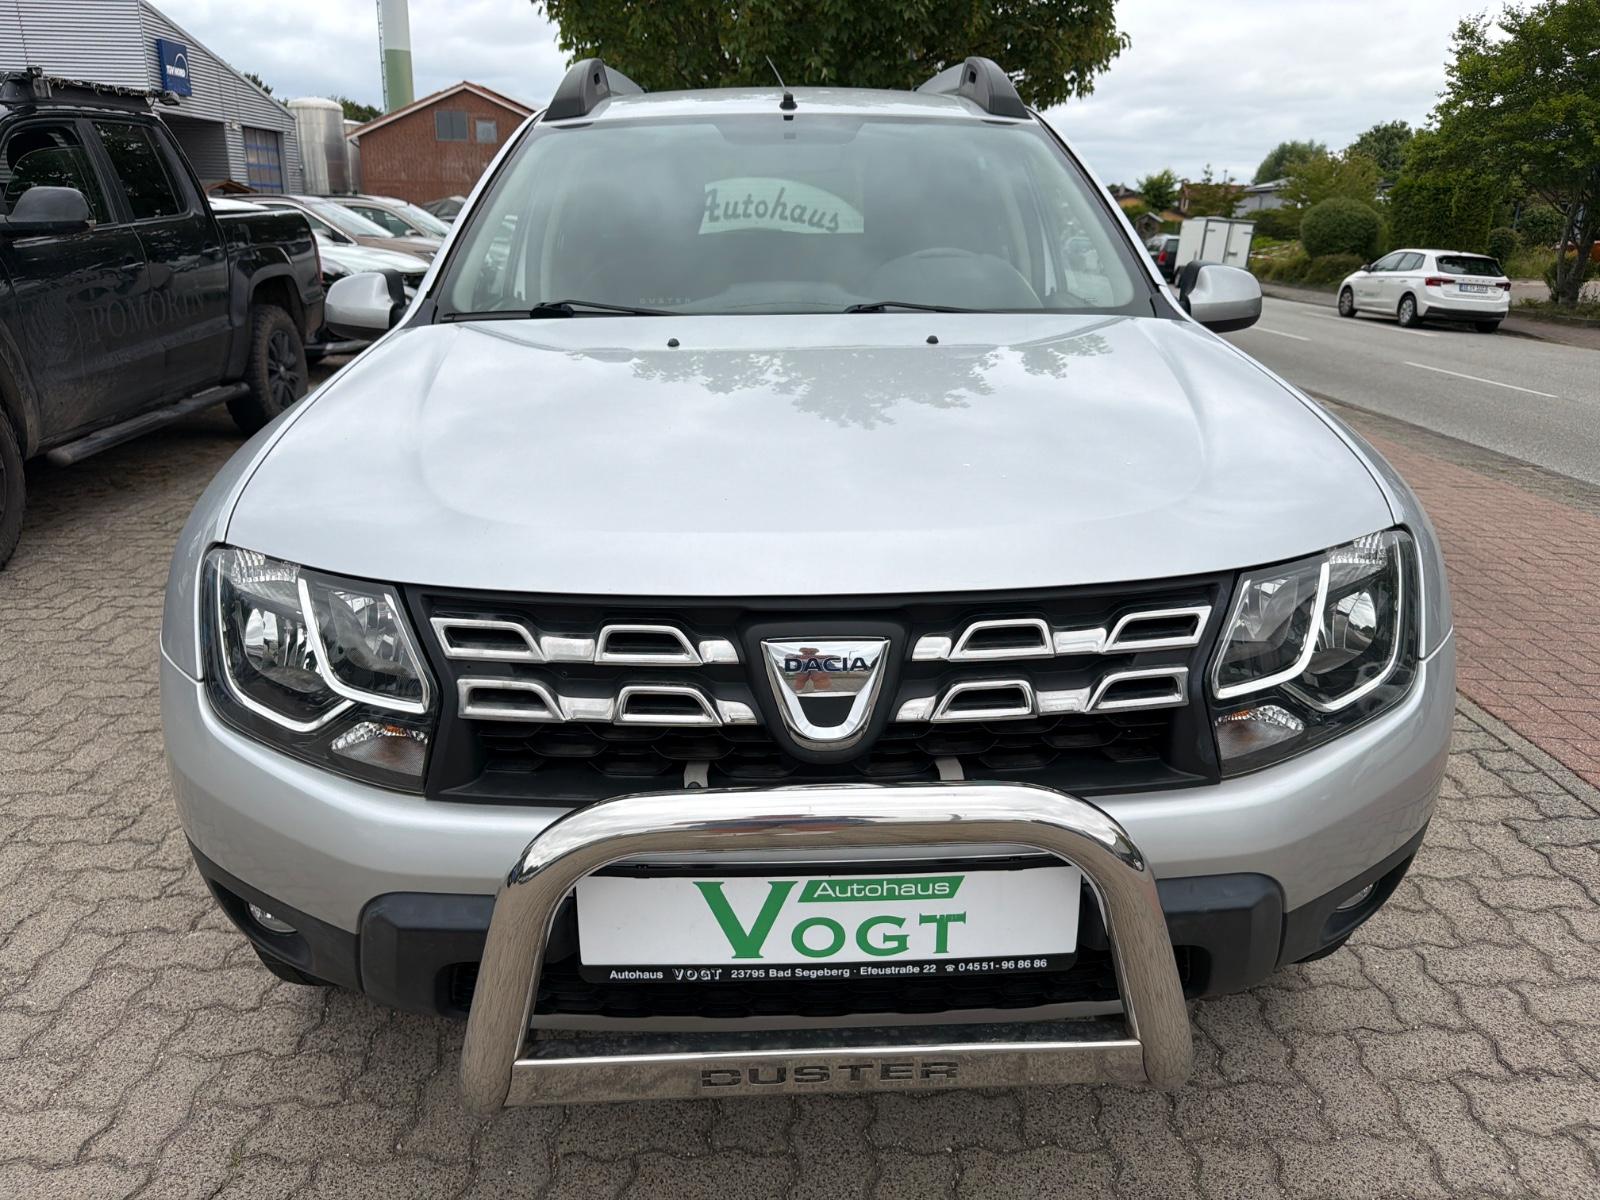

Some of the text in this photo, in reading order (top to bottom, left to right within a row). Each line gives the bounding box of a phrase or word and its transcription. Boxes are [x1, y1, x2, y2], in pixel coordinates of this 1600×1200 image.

[704, 187, 839, 232] Autohaus
[784, 657, 869, 672] DACIA
[813, 880, 950, 898] Autohaus
[609, 970, 664, 980] Autohaus
[672, 968, 722, 981] VOGT
[731, 969, 765, 979] 23795
[769, 968, 791, 978] Bad
[795, 967, 850, 979] Segeberg
[860, 965, 920, 975] Efeustraße
[922, 964, 937, 973] 22
[701, 1061, 959, 1087] DUSTER
